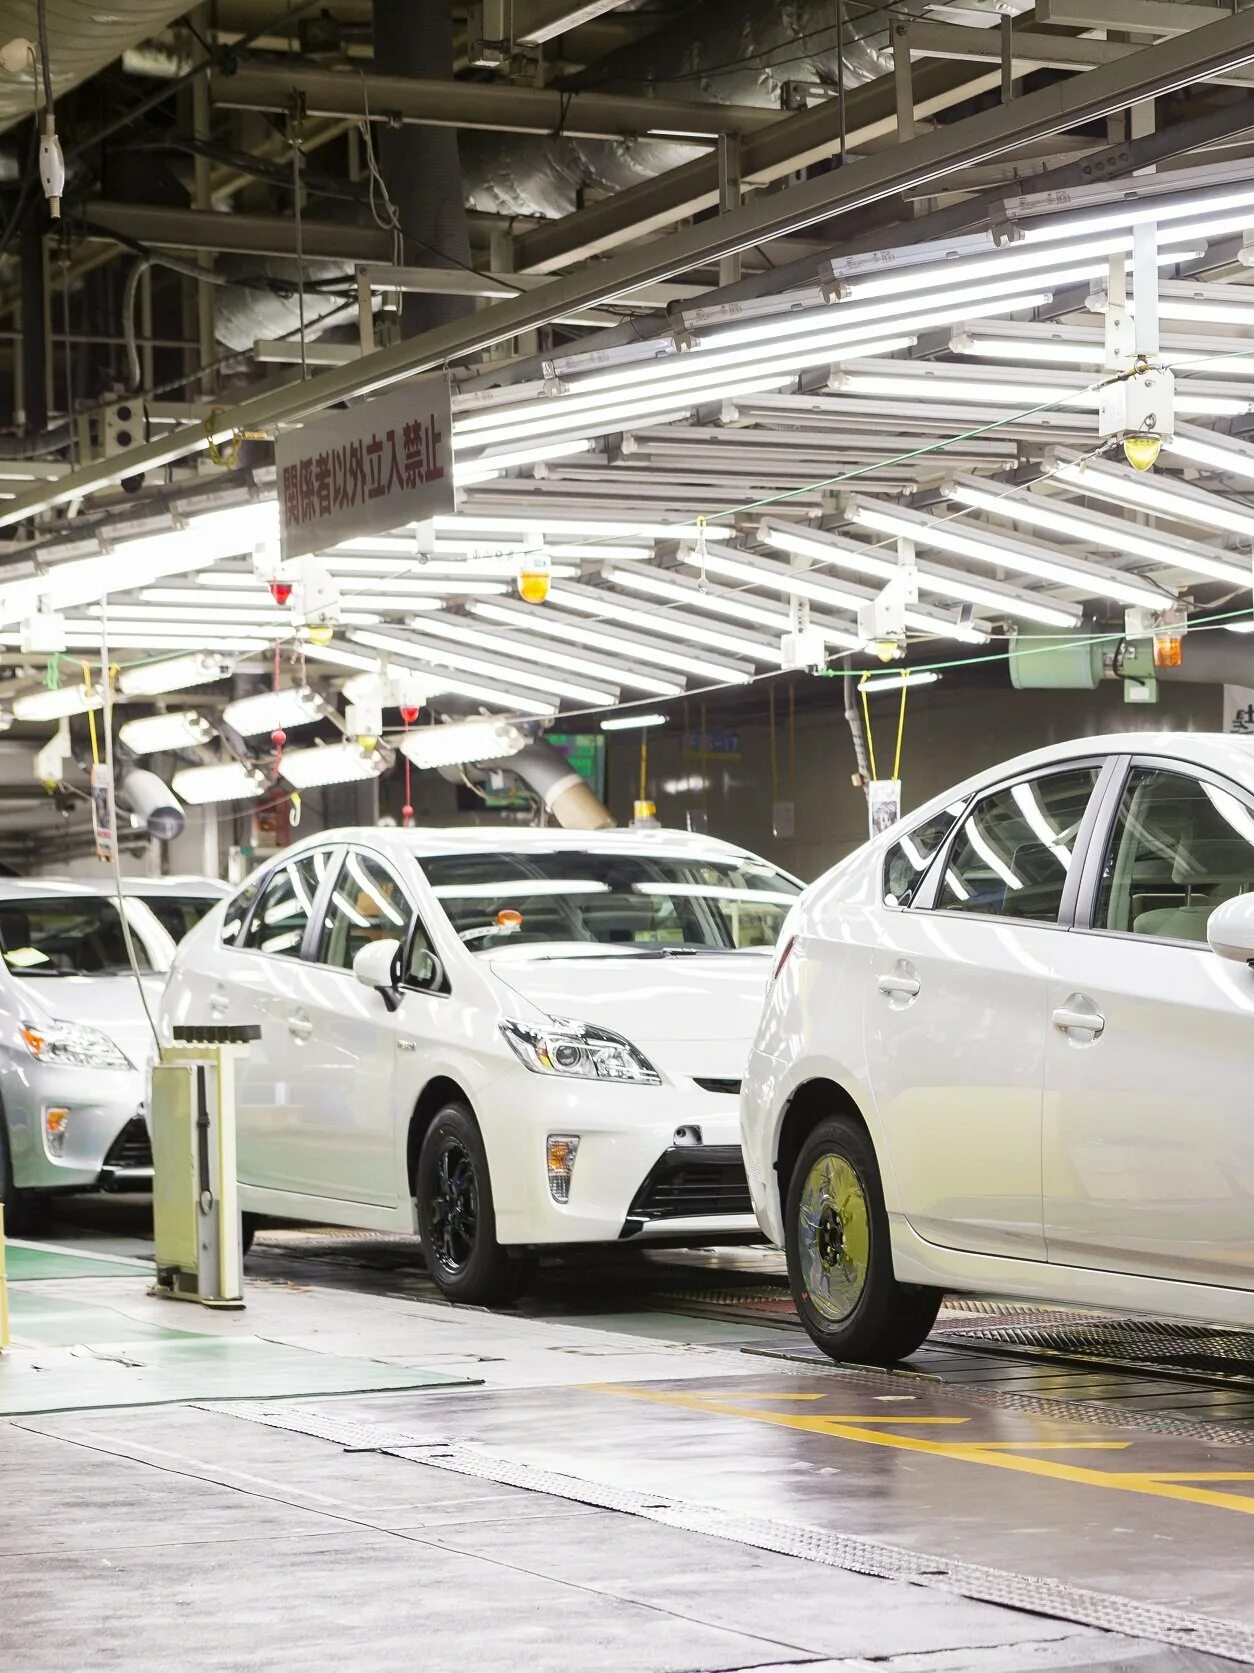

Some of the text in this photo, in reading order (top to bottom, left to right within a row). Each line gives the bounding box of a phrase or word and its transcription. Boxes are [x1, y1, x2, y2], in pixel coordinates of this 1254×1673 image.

[283, 414, 444, 526] 関係者以外立入禁止
